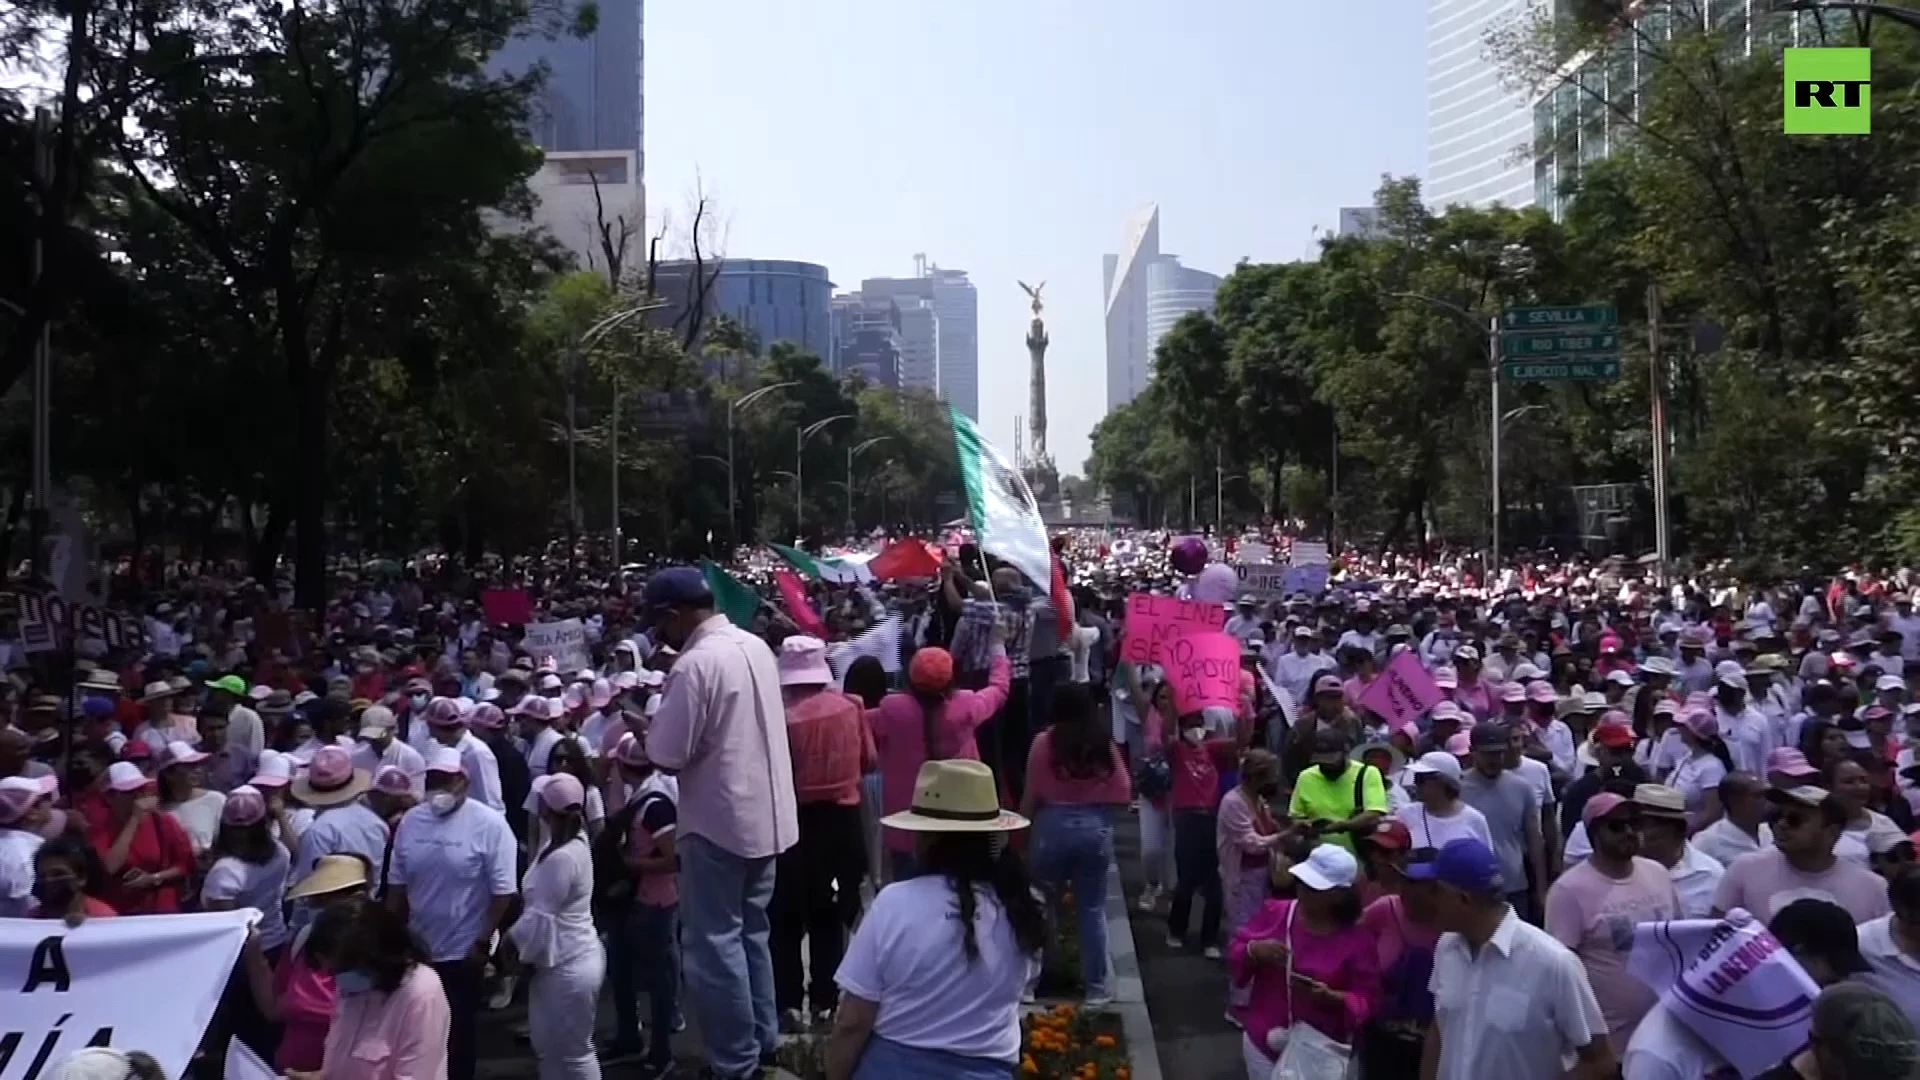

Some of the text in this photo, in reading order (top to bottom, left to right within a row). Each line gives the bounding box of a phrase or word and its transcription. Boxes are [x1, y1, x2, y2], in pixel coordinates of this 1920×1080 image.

[1528, 310, 1585, 323] SEVILLA
[1512, 365, 1569, 378] EJERCITO
[1135, 596, 1221, 626] EL INE
[1163, 639, 1194, 666] YO
[21, 936, 70, 992] A
